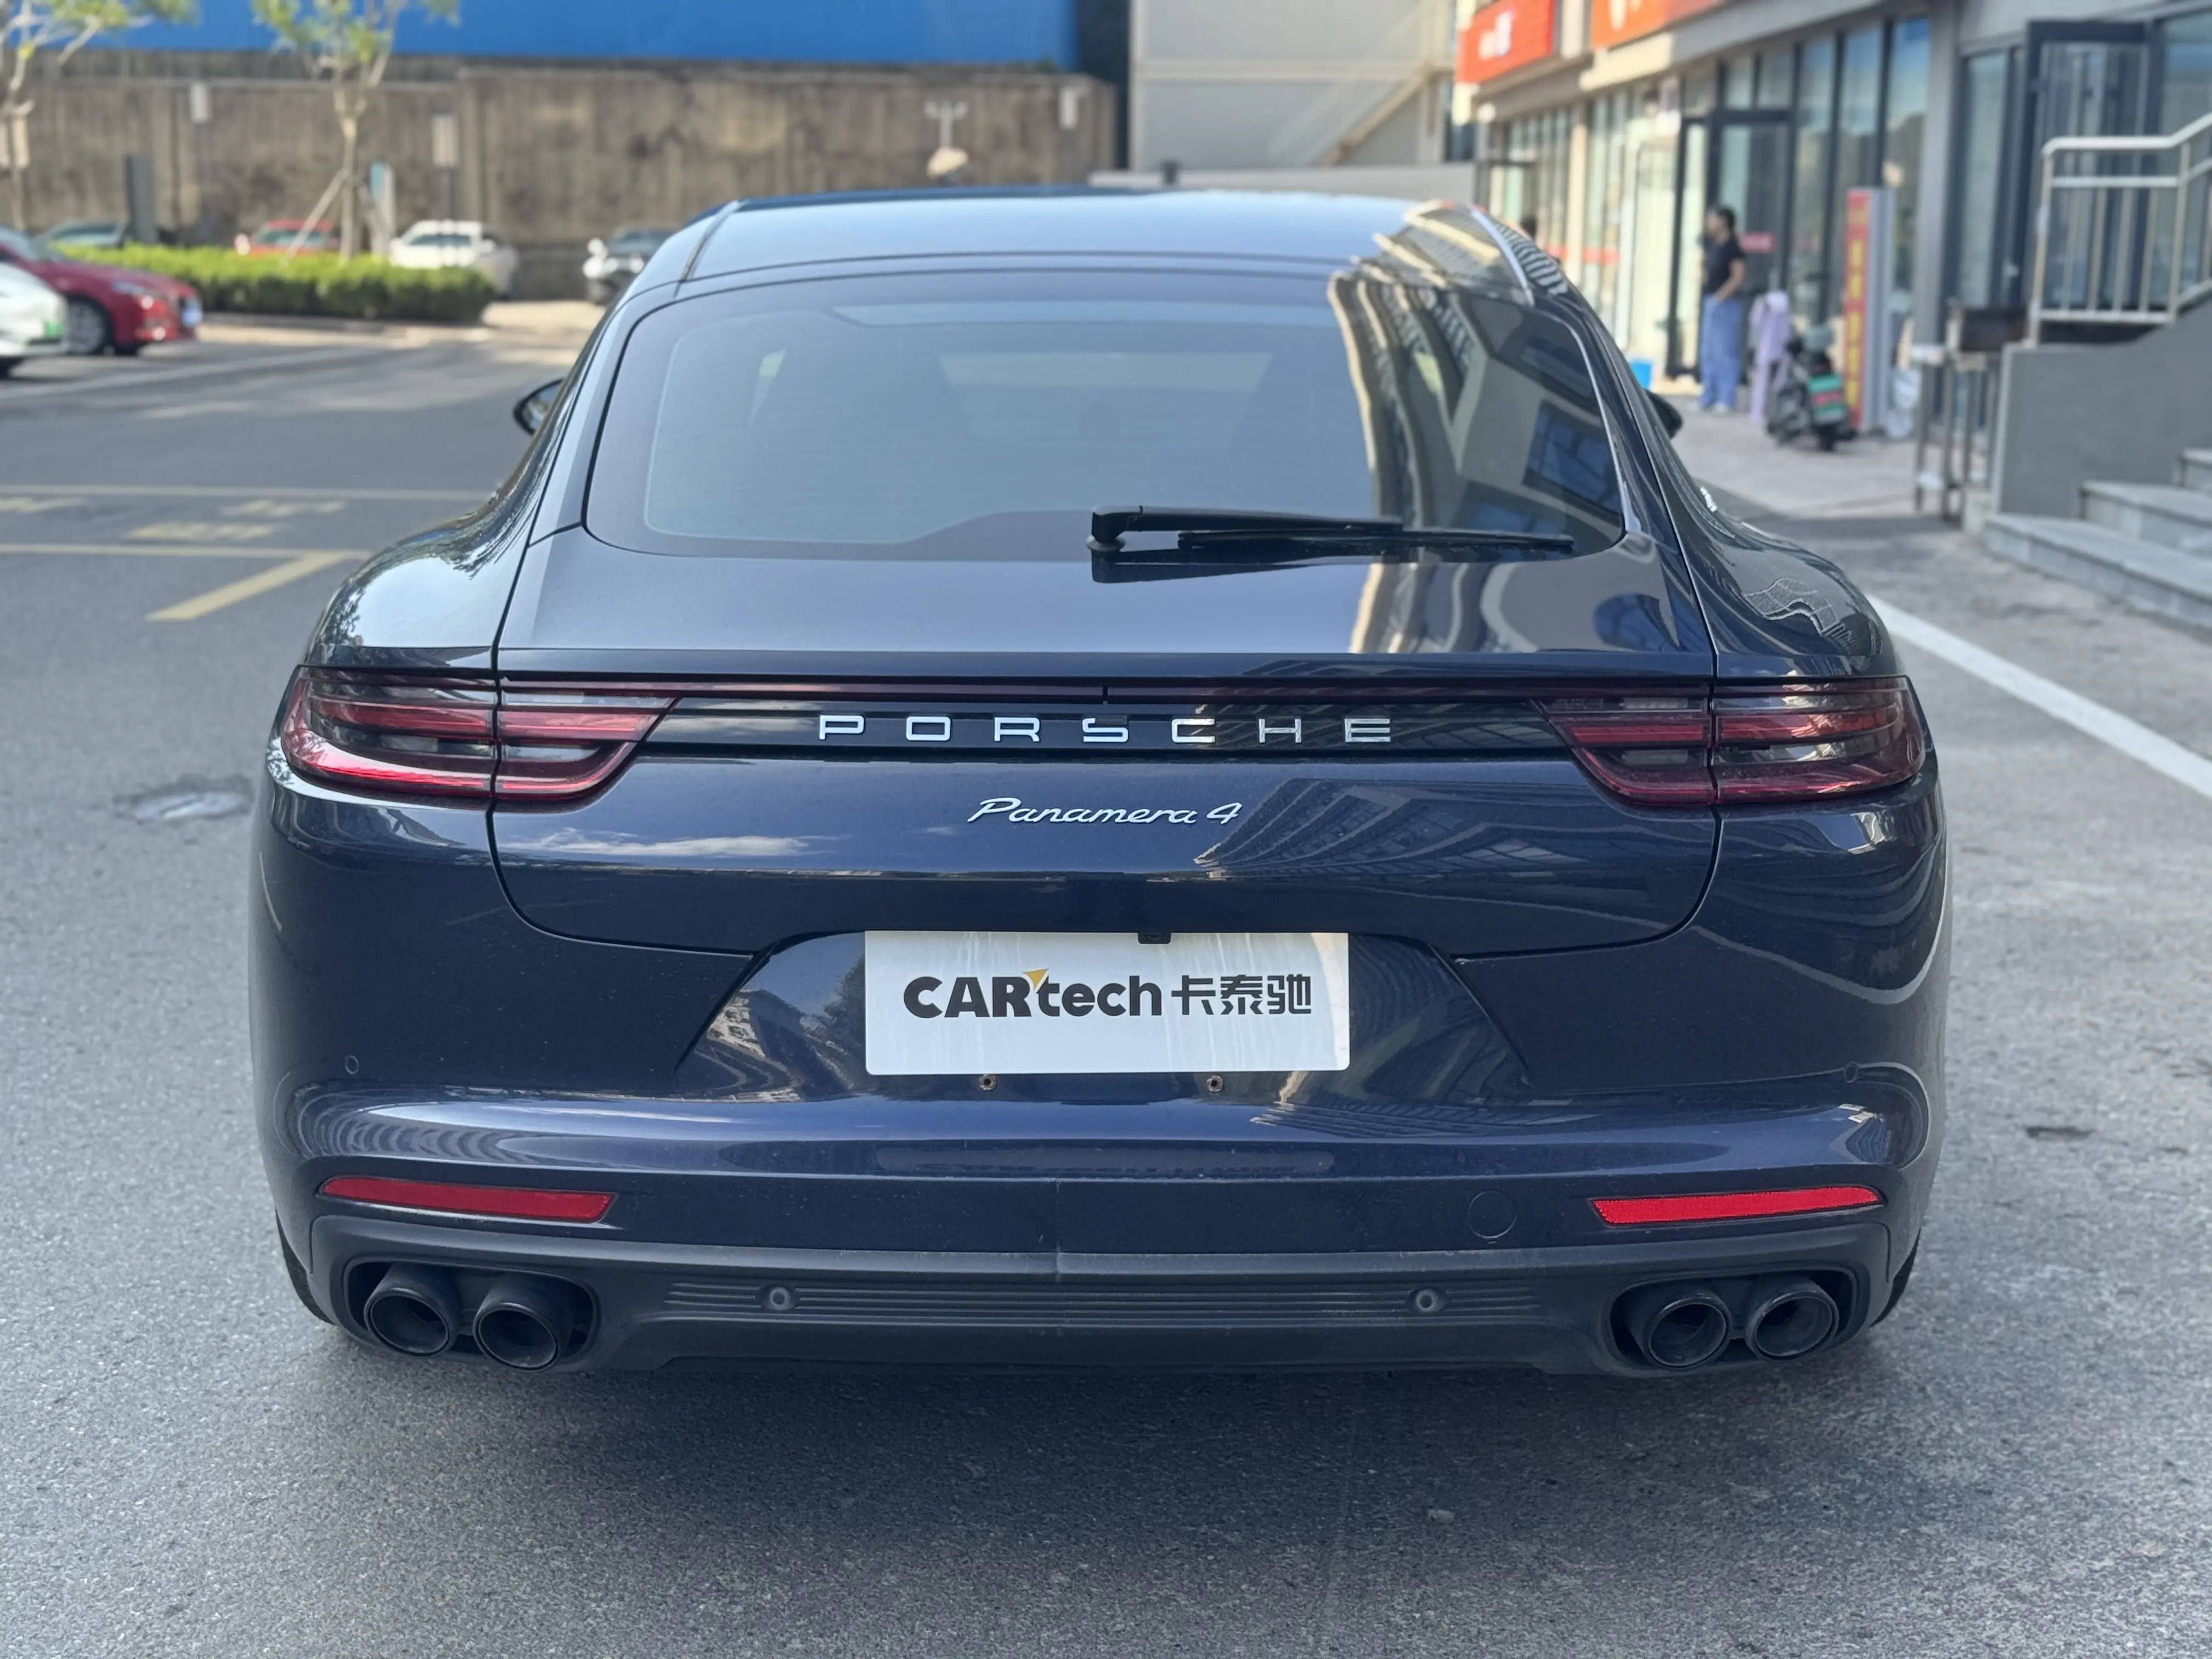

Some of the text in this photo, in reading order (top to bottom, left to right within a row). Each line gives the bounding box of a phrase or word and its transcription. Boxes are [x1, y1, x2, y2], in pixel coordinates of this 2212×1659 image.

[819, 714, 1391, 743] PORSCHE
[967, 796, 1243, 824] Panamera 4
[903, 974, 1312, 1019] CARtech 卡泰驰
